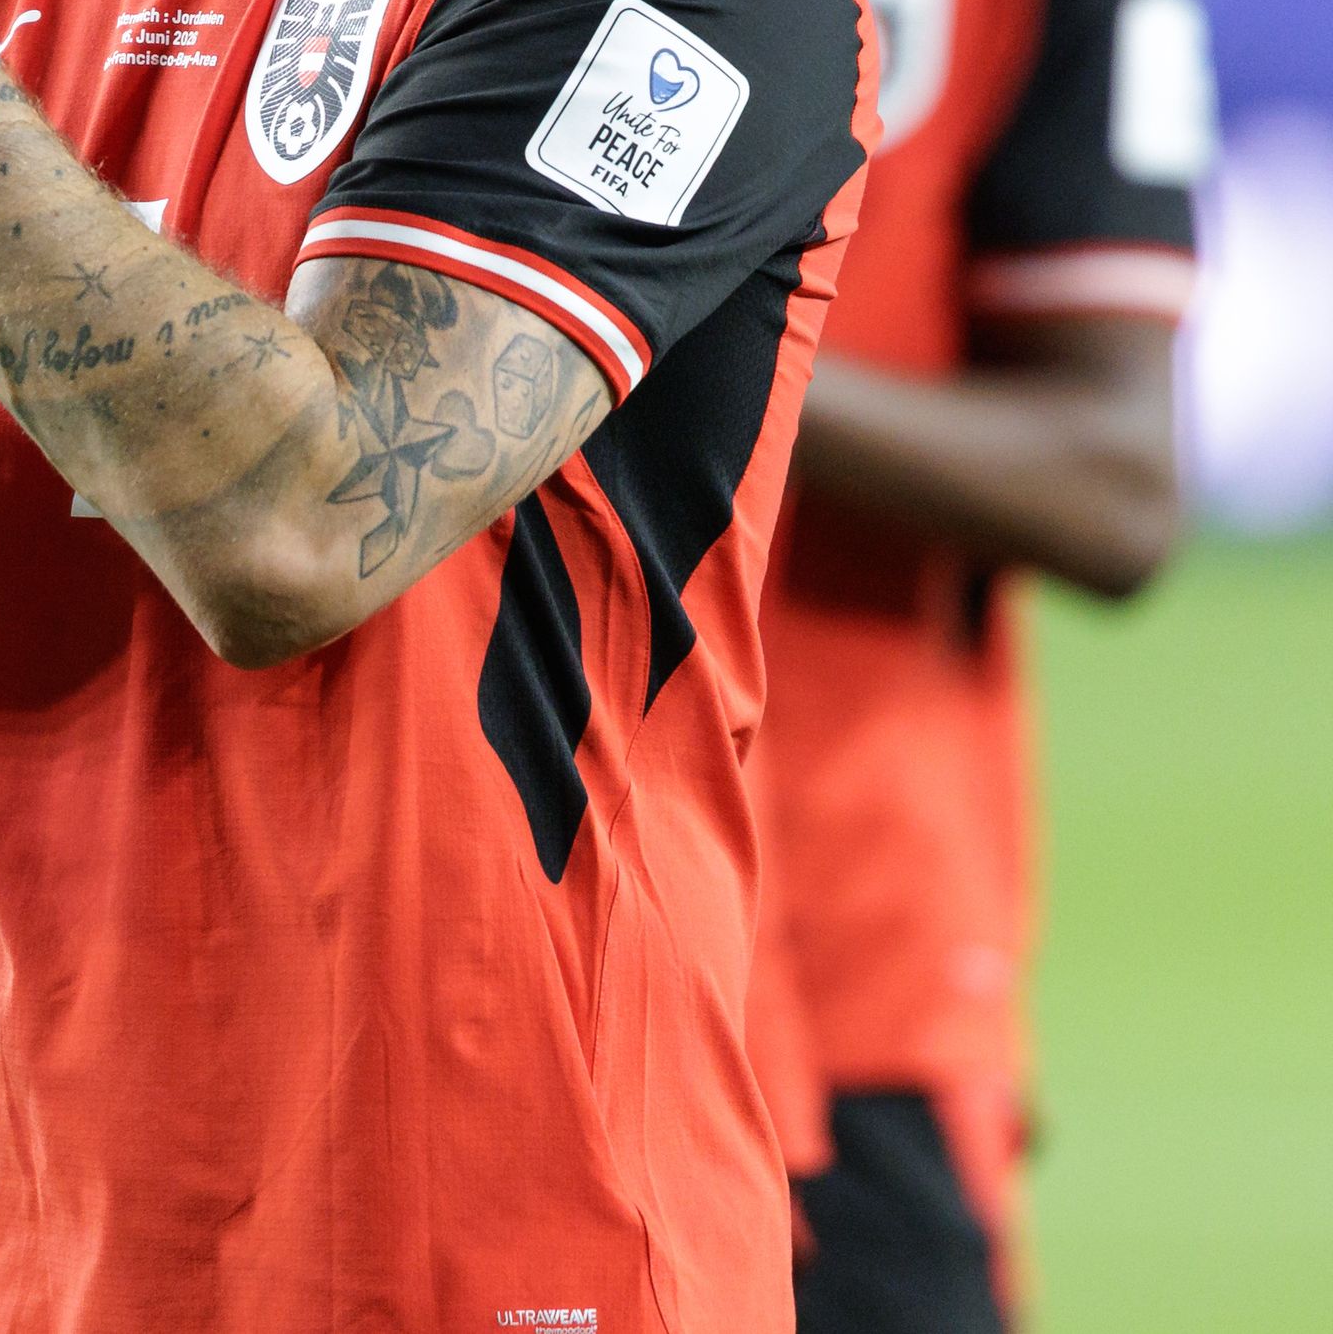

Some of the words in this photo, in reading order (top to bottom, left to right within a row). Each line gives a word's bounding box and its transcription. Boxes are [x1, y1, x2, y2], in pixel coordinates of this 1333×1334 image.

[136, 29, 170, 46] Juni
[602, 91, 656, 136] Unite
[652, 125, 681, 156] For
[588, 123, 664, 198] PEACE
[590, 165, 630, 198] FIFA
[497, 1308, 597, 1326] ULTRAWEAVE
